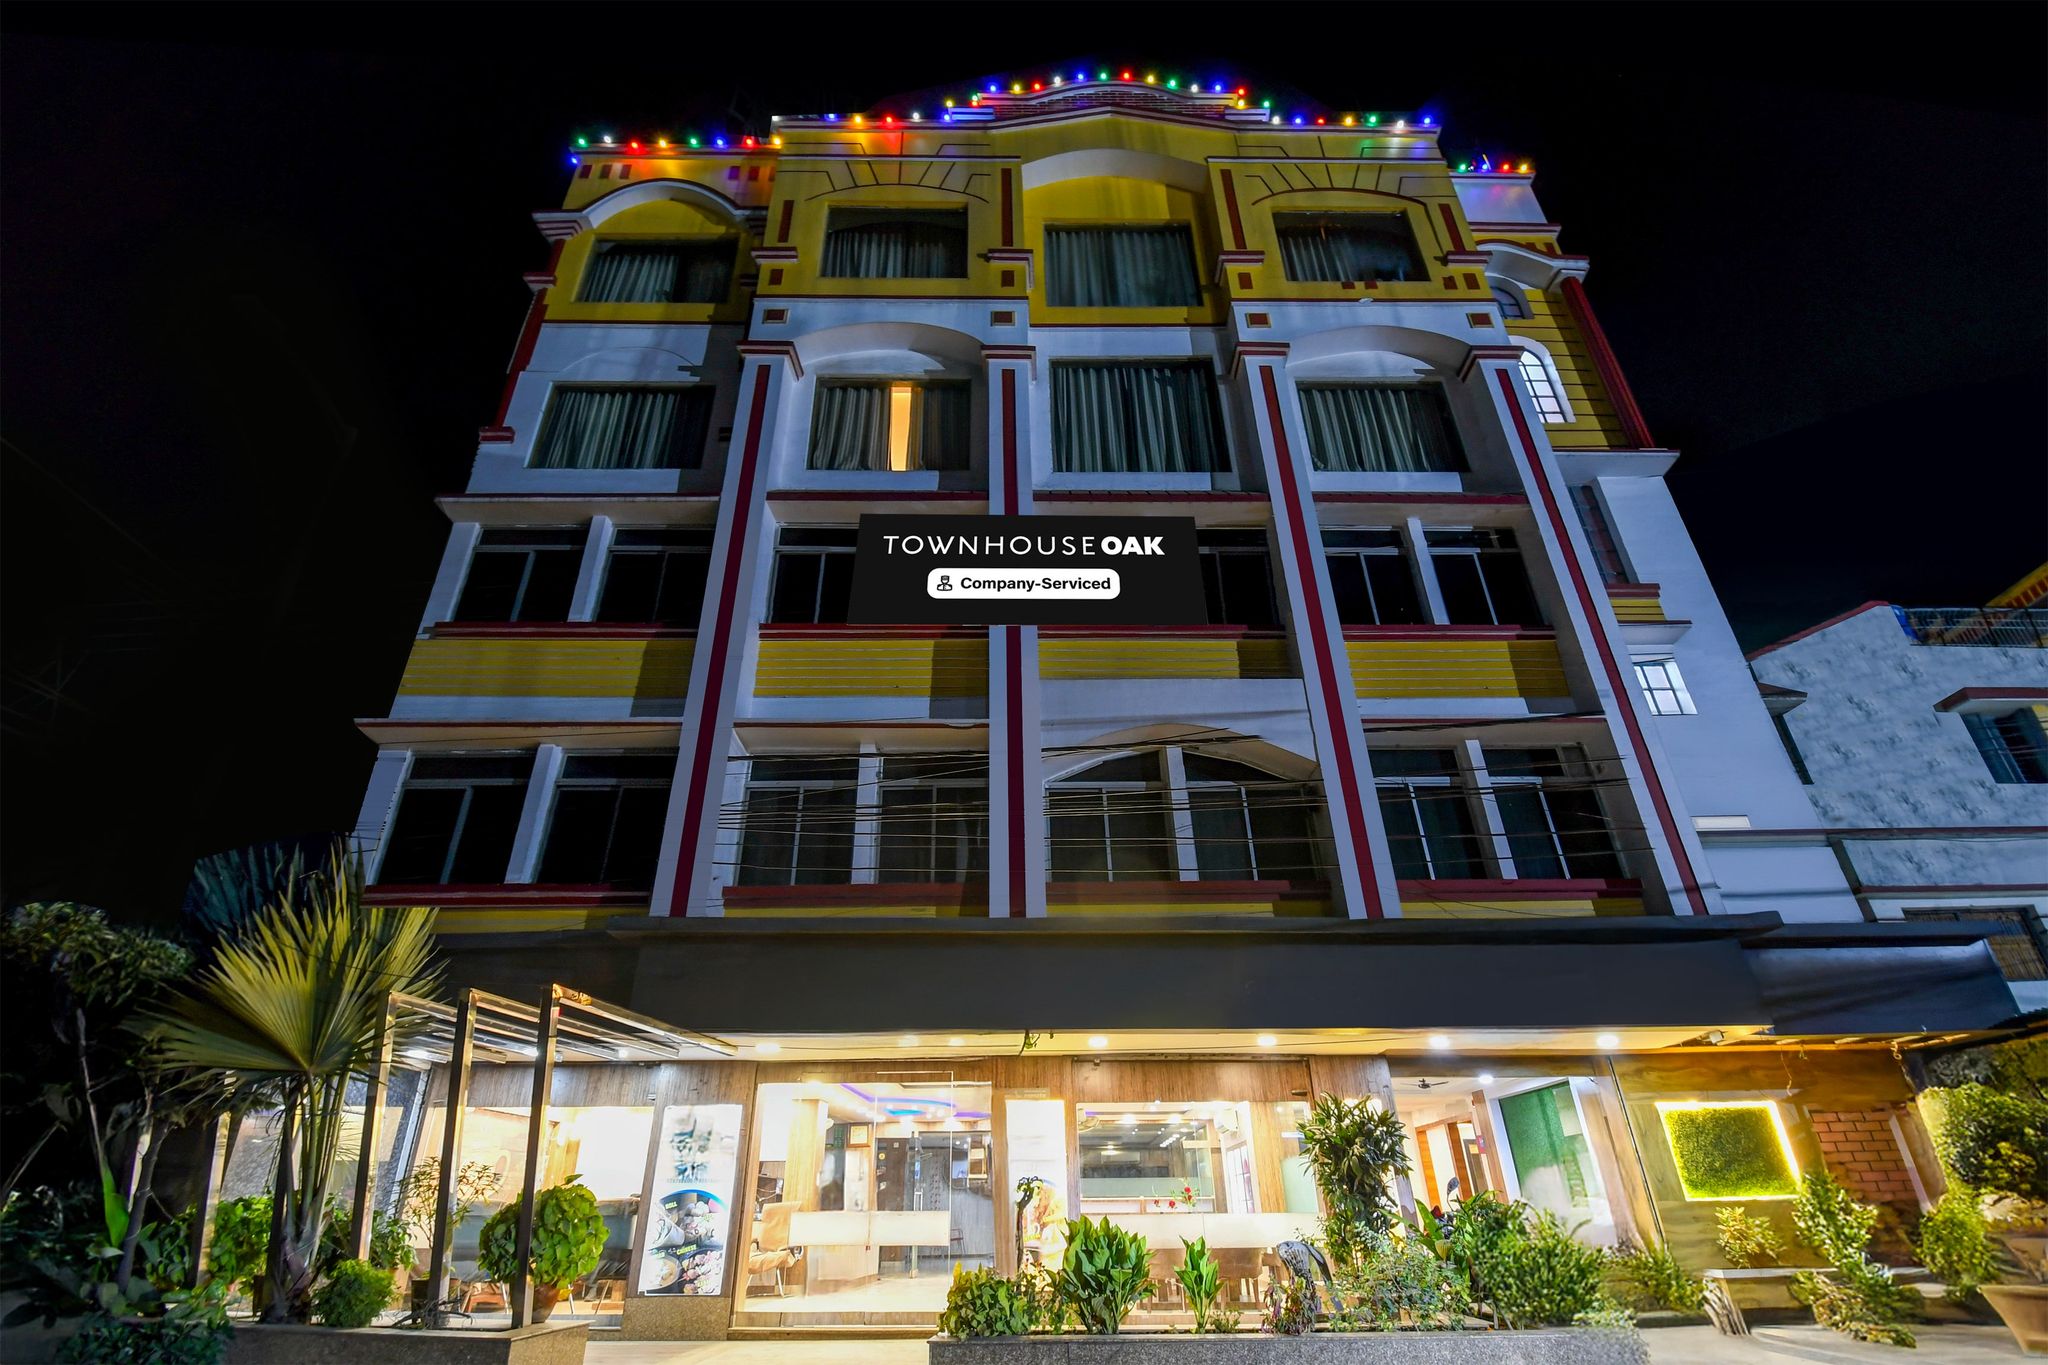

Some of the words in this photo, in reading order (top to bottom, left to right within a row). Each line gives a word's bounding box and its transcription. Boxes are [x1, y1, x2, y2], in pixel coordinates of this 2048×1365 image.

[883, 535, 1095, 556] TOWNHOUSE
[1100, 535, 1165, 556] OAK
[960, 576, 1111, 593] Company-Serviced
